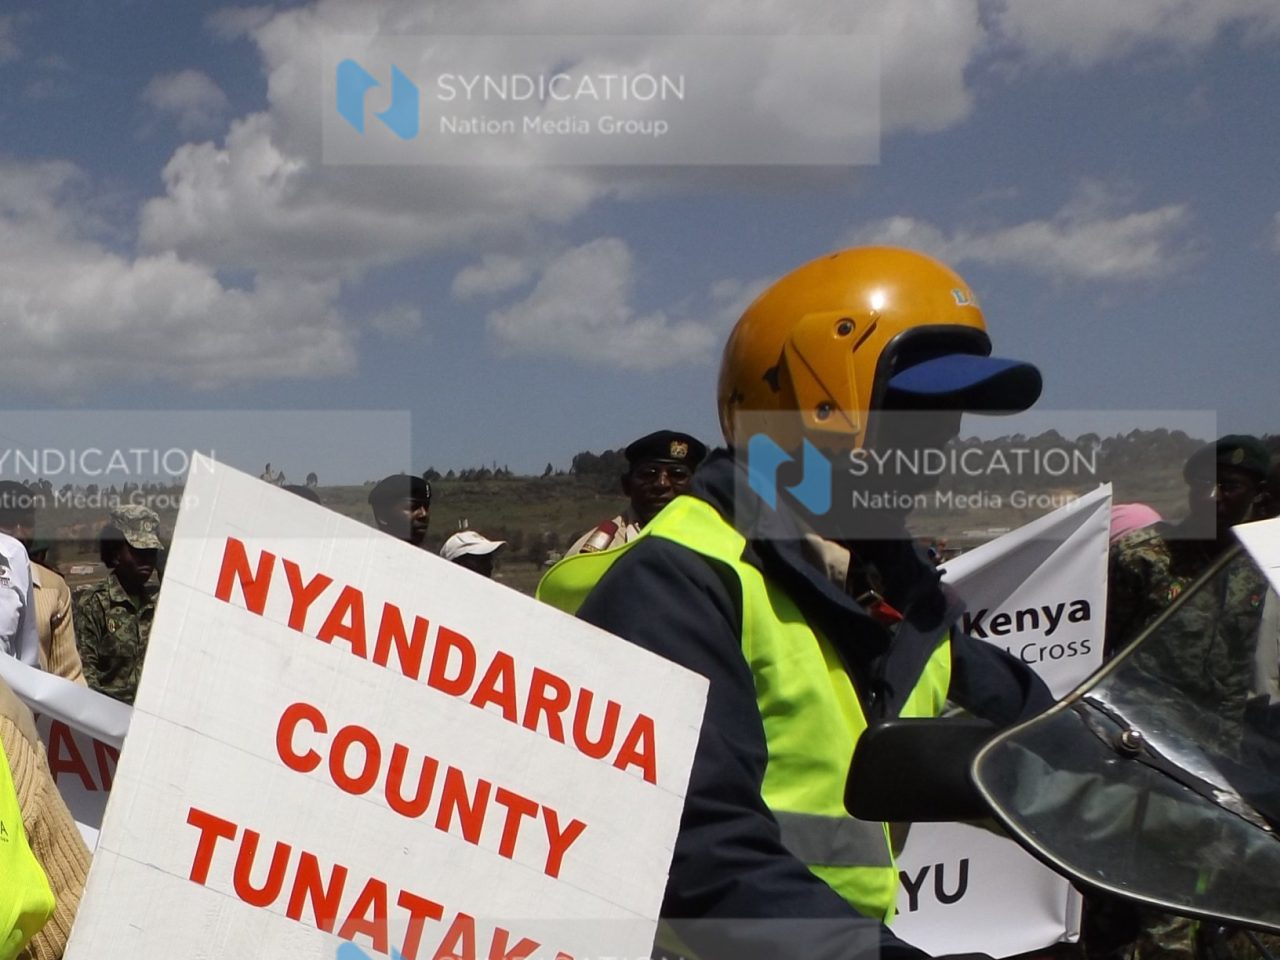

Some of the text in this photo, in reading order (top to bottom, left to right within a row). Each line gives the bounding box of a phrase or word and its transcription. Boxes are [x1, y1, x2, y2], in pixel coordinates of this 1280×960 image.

[962, 599, 1091, 638] Kenya
[214, 537, 658, 785] NYANDARUA
[1020, 639, 1091, 664] Cross
[275, 702, 587, 879] COUNTY
[895, 858, 969, 915] YU
